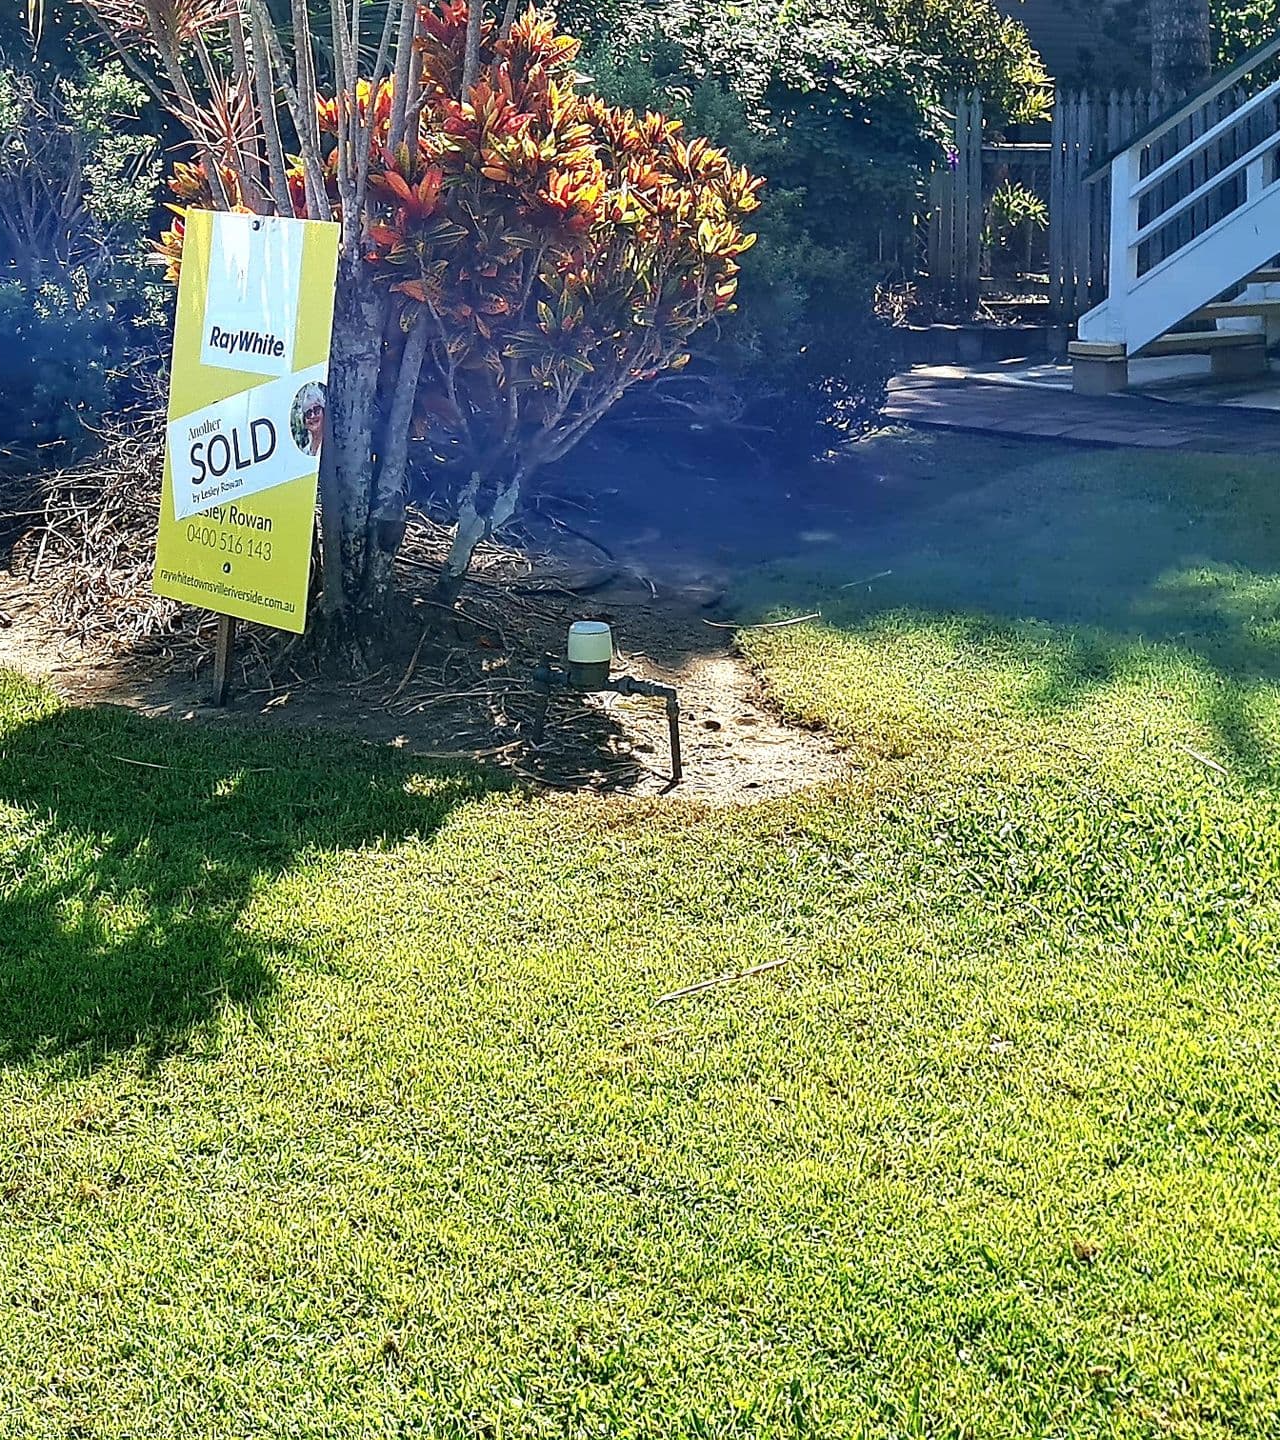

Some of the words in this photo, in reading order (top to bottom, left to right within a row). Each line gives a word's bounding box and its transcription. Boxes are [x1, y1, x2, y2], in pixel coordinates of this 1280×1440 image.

[188, 418, 222, 441] Another
[190, 417, 277, 485] SOLD
[192, 492, 201, 504] by
[201, 485, 220, 500] Lesley
[220, 478, 244, 493] Rowan
[195, 505, 227, 525] sley
[229, 504, 273, 532] Rowan
[186, 523, 217, 548] 0400
[219, 532, 243, 555] 516
[247, 539, 272, 562] 143
[160, 569, 296, 613] raywhitetownsvilleriverside.com.au
